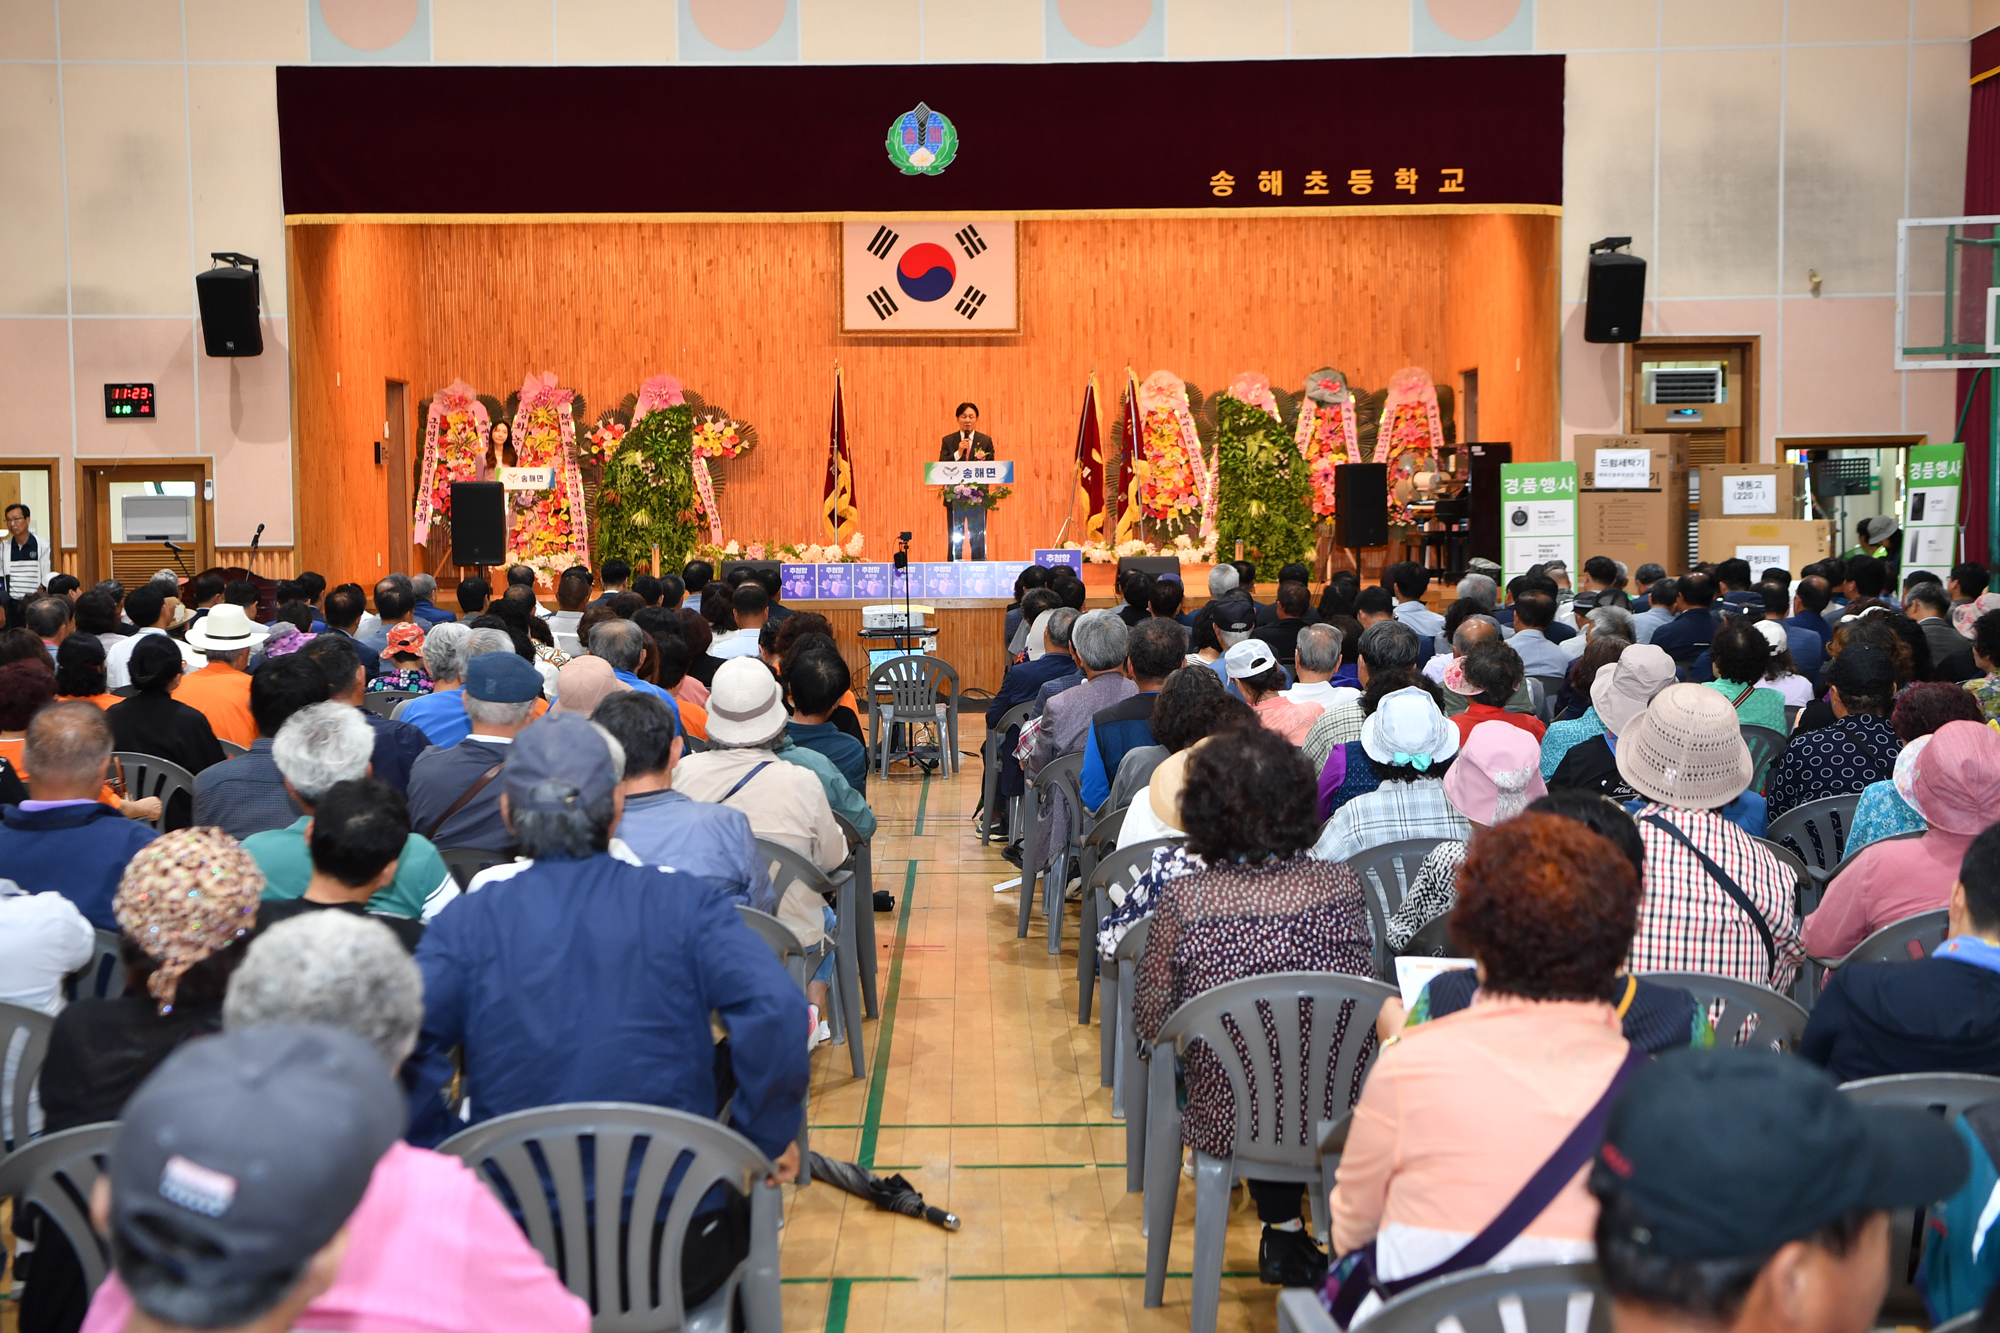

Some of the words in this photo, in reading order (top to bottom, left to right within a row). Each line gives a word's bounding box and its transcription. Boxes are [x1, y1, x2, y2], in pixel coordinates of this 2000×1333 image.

[114, 387, 149, 400] 11:23
[1600, 458, 1645, 467] 드럼세탁기
[963, 467, 996, 479] 송해면
[1909, 460, 1962, 480] 경품행사
[1504, 476, 1575, 495] 경품행사
[1736, 480, 1763, 490] 냉동고
